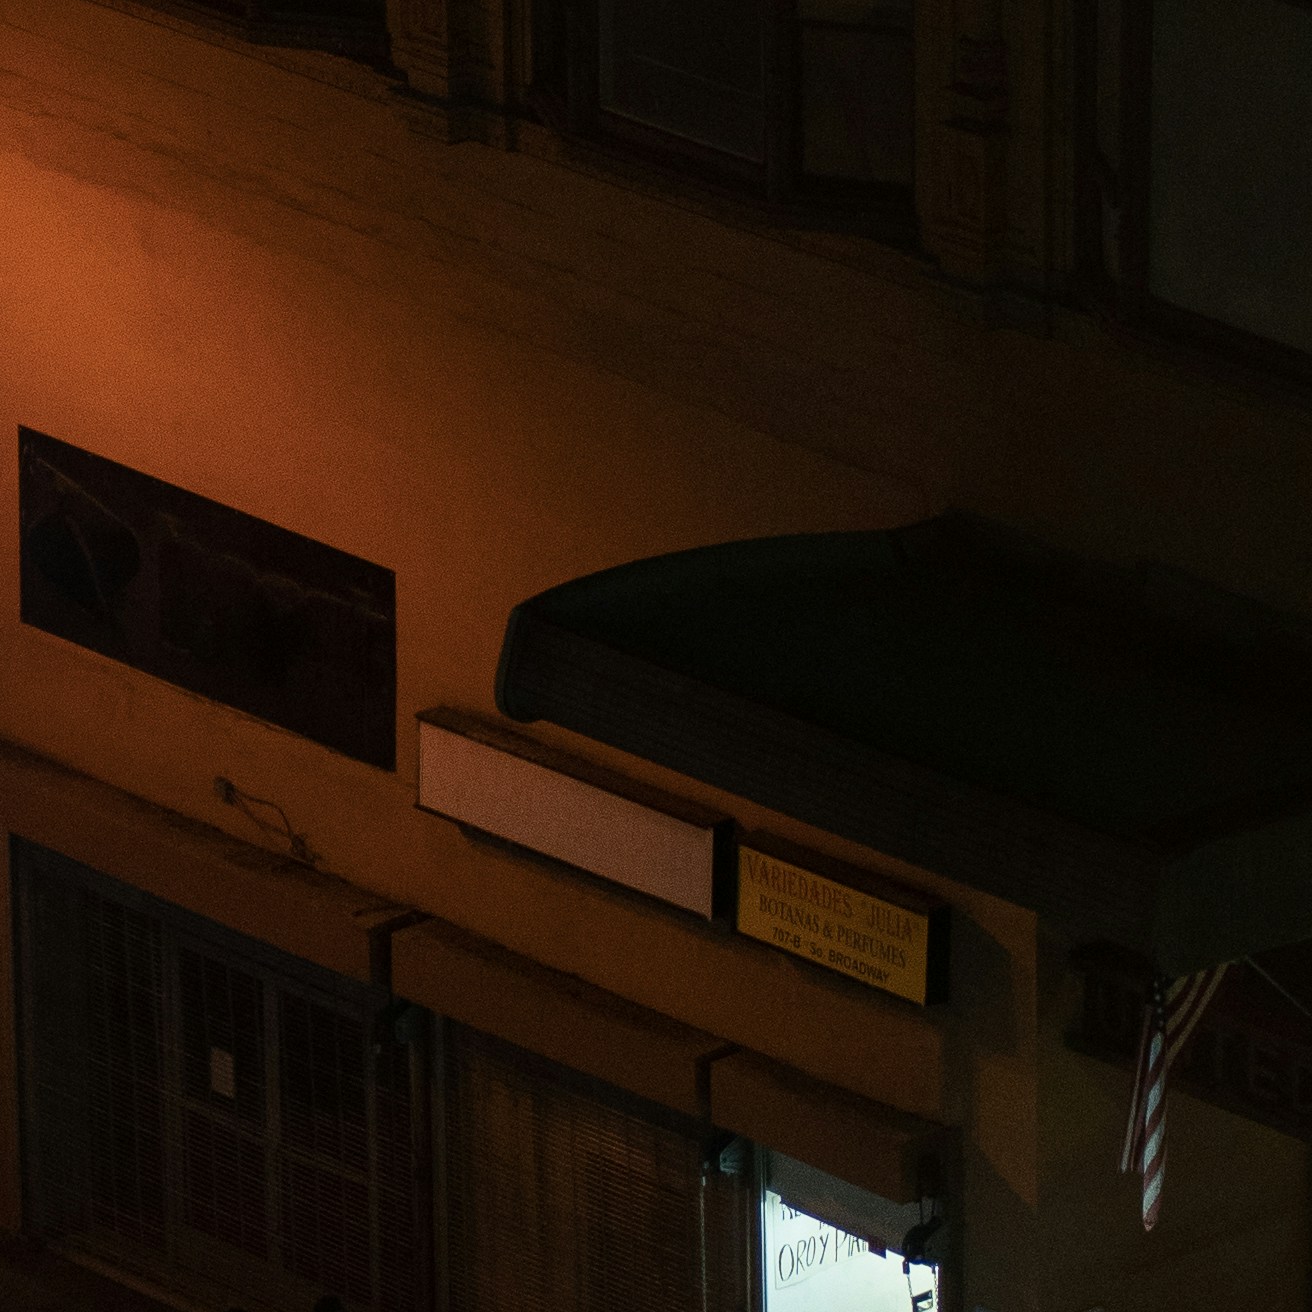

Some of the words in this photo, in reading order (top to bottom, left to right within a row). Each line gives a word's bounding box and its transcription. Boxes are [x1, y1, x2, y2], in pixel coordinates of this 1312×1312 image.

[747, 854, 853, 919] VARIEDADES
[759, 895, 820, 935] BOTANAS
[837, 926, 906, 969] PERFUMES
[773, 928, 802, 950] 707-B
[828, 949, 890, 982] BROADWAY
[778, 1235, 816, 1282] ORO
